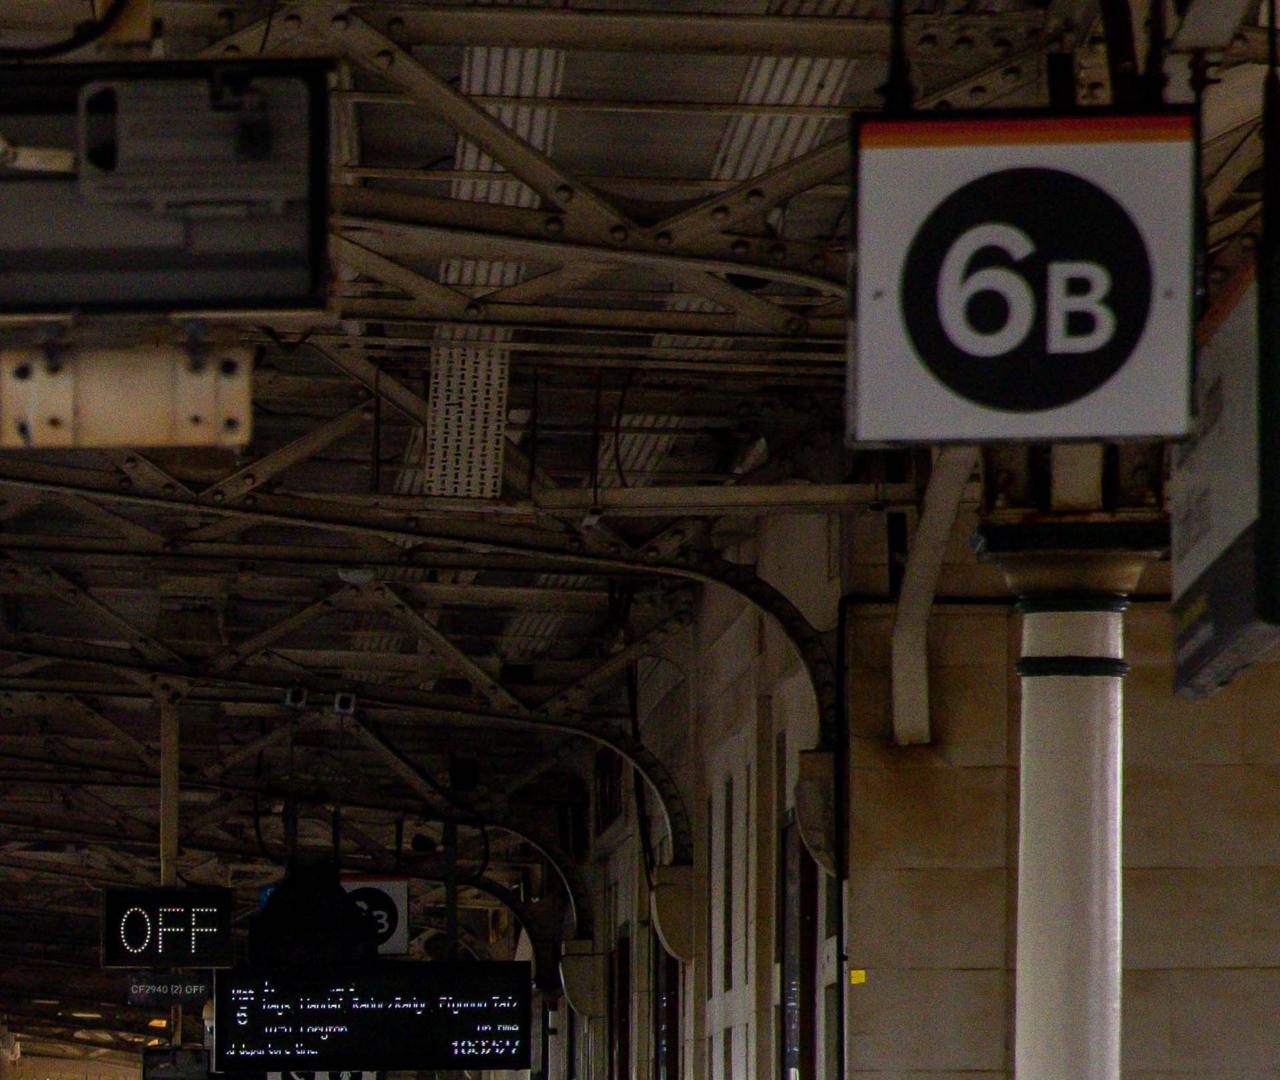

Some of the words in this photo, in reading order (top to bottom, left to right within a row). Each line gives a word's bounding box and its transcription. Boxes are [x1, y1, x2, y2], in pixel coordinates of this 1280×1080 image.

[938, 222, 1117, 358] 6B
[120, 906, 218, 954] OFF
[131, 984, 168, 995] CF2940
[170, 984, 183, 997] (2)
[185, 985, 205, 995] OFF
